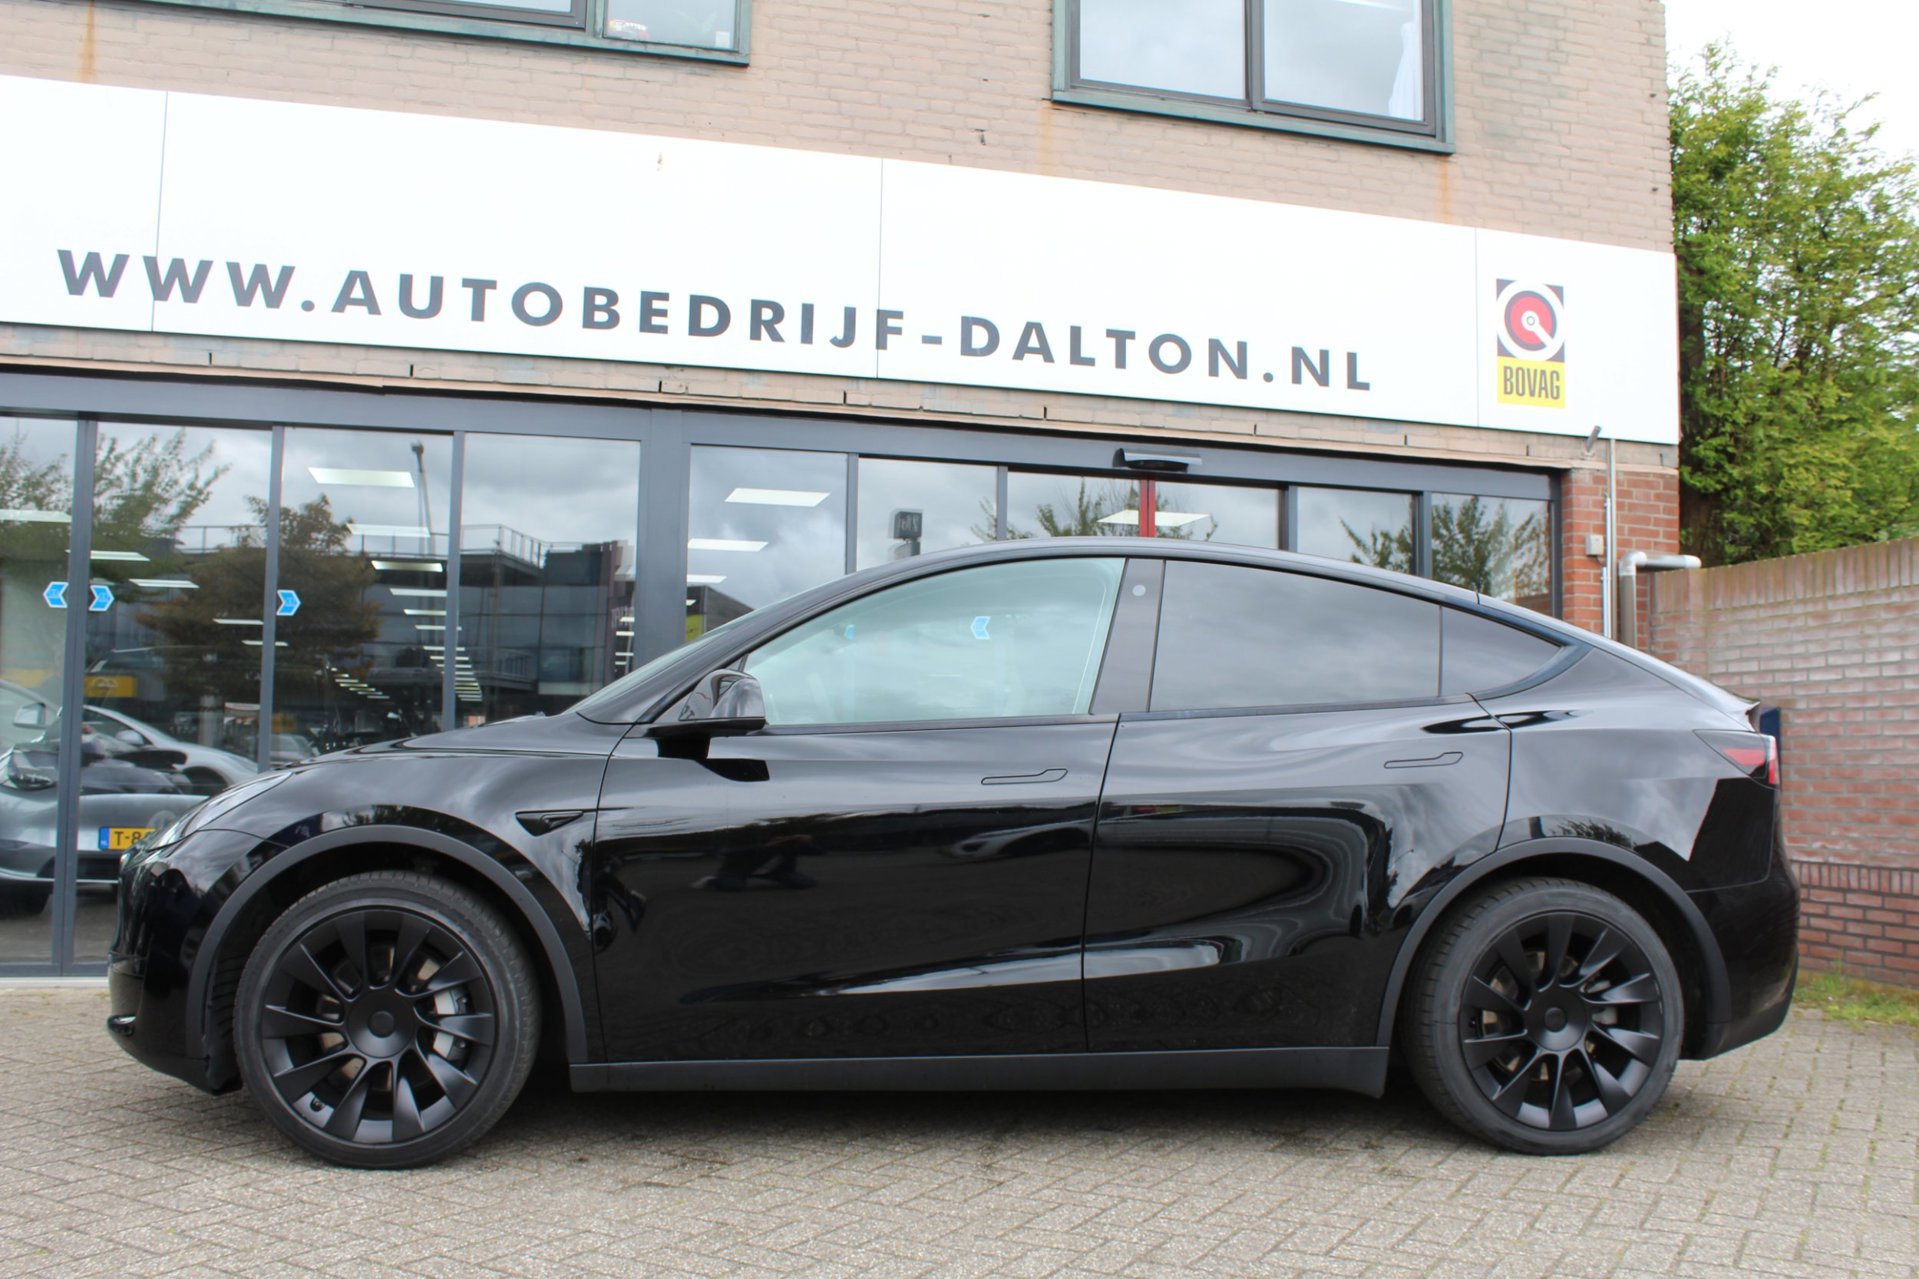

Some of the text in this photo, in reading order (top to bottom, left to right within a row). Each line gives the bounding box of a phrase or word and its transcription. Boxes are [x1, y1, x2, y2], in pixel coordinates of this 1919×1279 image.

[57, 249, 1371, 391] WWW.AUTOBEDRIJF-DALTON.NL
[1503, 366, 1560, 400] BOVAG
[114, 831, 150, 847] T-8
